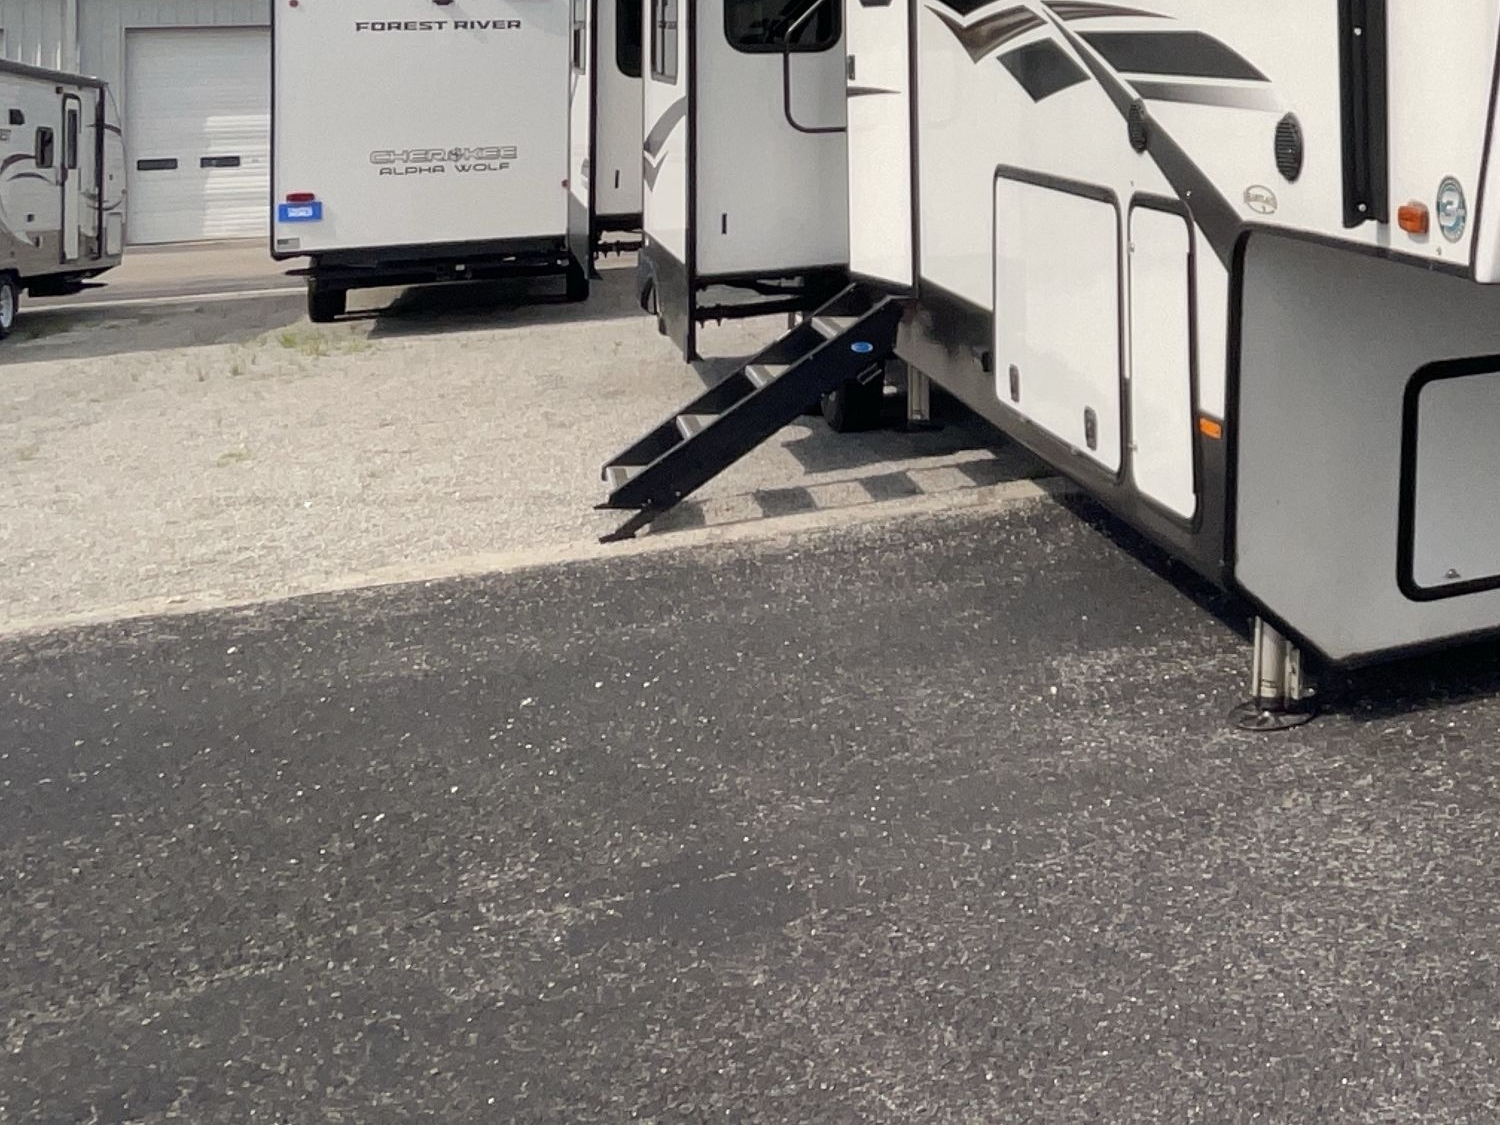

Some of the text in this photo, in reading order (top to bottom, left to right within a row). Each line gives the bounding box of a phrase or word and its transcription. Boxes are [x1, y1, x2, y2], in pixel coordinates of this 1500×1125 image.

[355, 19, 522, 32] FOREST RIVER
[379, 162, 510, 176] ALPHA WOLF
